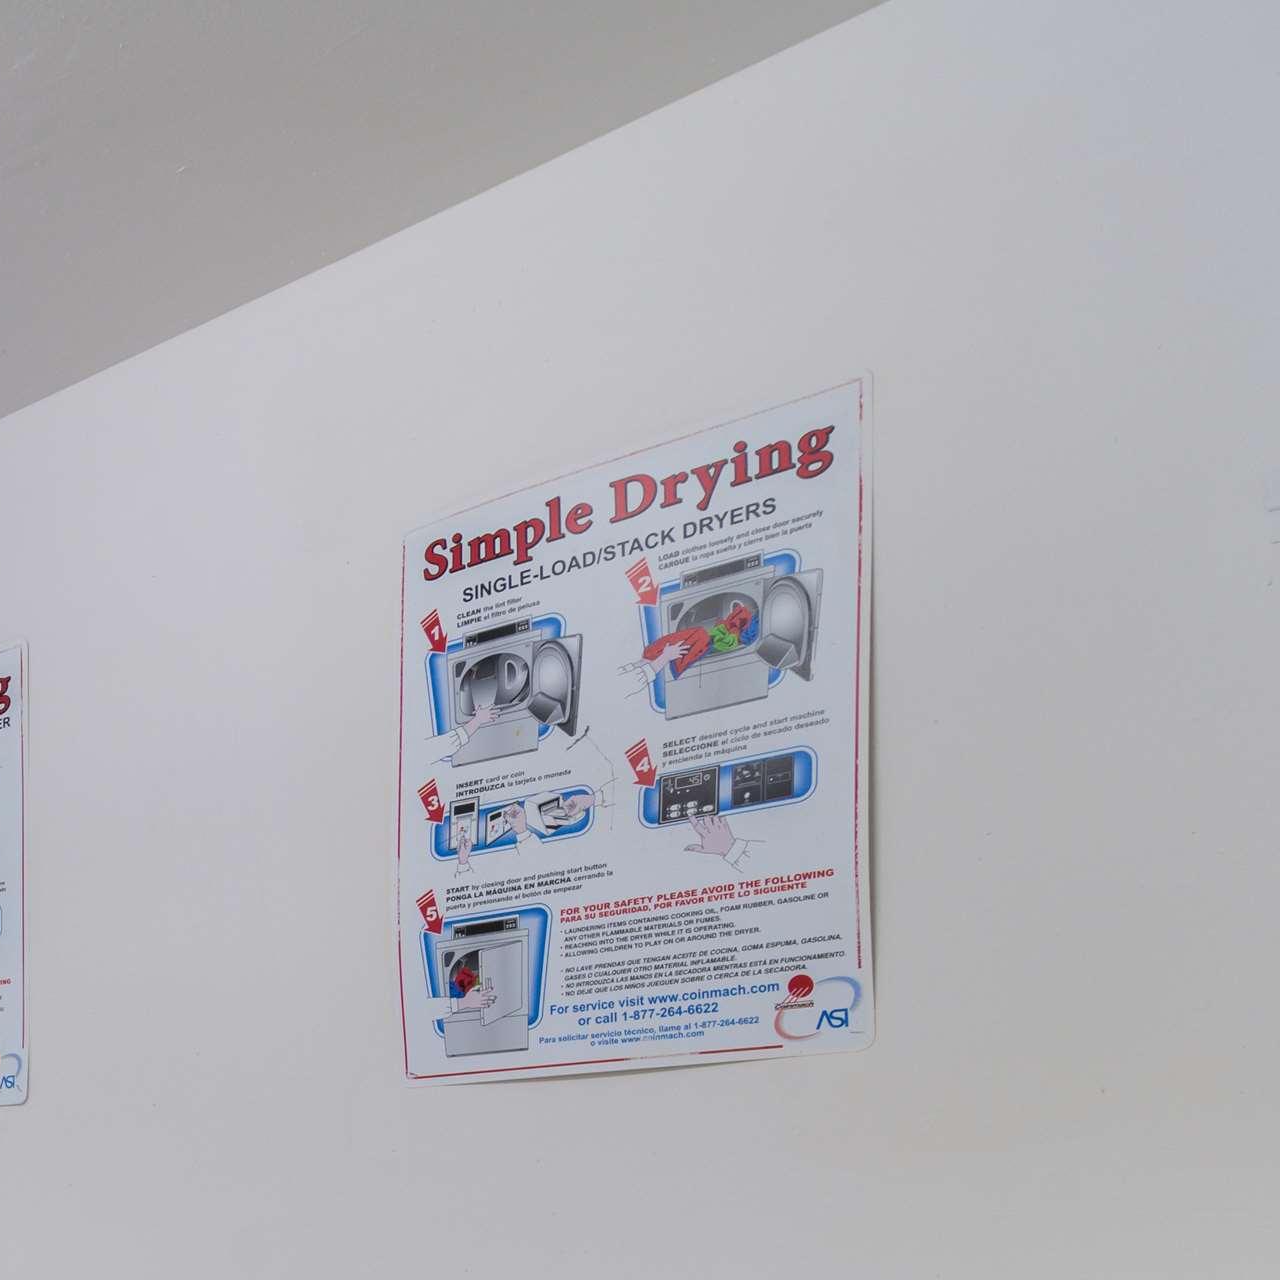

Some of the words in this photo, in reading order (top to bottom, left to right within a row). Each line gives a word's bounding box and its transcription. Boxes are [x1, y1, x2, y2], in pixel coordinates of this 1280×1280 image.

[423, 497, 594, 582] Simple
[609, 425, 835, 524] Drying
[462, 530, 676, 603] SINGLE-LOAD/STACK
[681, 498, 777, 537] DRYERS
[638, 577, 652, 592] 2
[431, 626, 441, 642] 1
[662, 736, 696, 749] SELECT
[700, 729, 728, 741] desired
[730, 724, 750, 736] cycle
[752, 721, 768, 730] and
[769, 717, 788, 726] start
[662, 740, 718, 758] SELECCIONE
[750, 731, 761, 739] de
[635, 756, 650, 773] 4
[456, 778, 484, 790] INSERT
[486, 775, 500, 784] card
[502, 773, 510, 781] or
[511, 770, 524, 779] coin
[456, 782, 506, 798] INTRODUZCA
[427, 796, 438, 811] 3
[446, 885, 470, 895] START
[472, 883, 480, 892] by
[480, 879, 504, 890] closing
[506, 876, 522, 885] door
[523, 874, 536, 882] and
[537, 869, 565, 881] pushing
[566, 866, 583, 875] start
[584, 862, 608, 872] button
[446, 892, 472, 902] PONGA
[474, 890, 484, 898] LA
[524, 882, 535, 890] EN
[537, 876, 572, 888] MARCHA
[560, 906, 580, 916] FOR
[583, 901, 611, 913] YOUR
[614, 895, 654, 908] SAFETY
[656, 889, 698, 902] PLEASE
[700, 883, 734, 896] AVOID
[740, 879, 760, 890] THE
[764, 869, 834, 886] FOLLOWING
[560, 914, 580, 924] PARA
[584, 912, 596, 920] SU
[654, 901, 672, 910] POR
[675, 896, 705, 907] FAVOR
[708, 892, 735, 902] EVITE
[739, 890, 750, 898] LO
[753, 881, 808, 896] SIGUIENTE
[426, 906, 437, 922] 5
[599, 938, 614, 946] INTO
[630, 933, 654, 942] DRYER
[654, 930, 676, 938] WHILE
[550, 1003, 568, 1015] For
[572, 999, 614, 1013] service
[618, 996, 644, 1008] visit
[648, 982, 780, 1005] www.coinmach.com
[578, 1014, 592, 1025] or
[595, 1012, 618, 1024] call
[623, 1002, 720, 1021] 1-877-264-6622
[539, 1036, 556, 1045] Para
[558, 1032, 588, 1043] solicitar
[590, 1029, 622, 1040] servicio
[658, 1023, 680, 1033] llame
[683, 1022, 690, 1031] al
[694, 1015, 760, 1030] 1-877-264-6622
